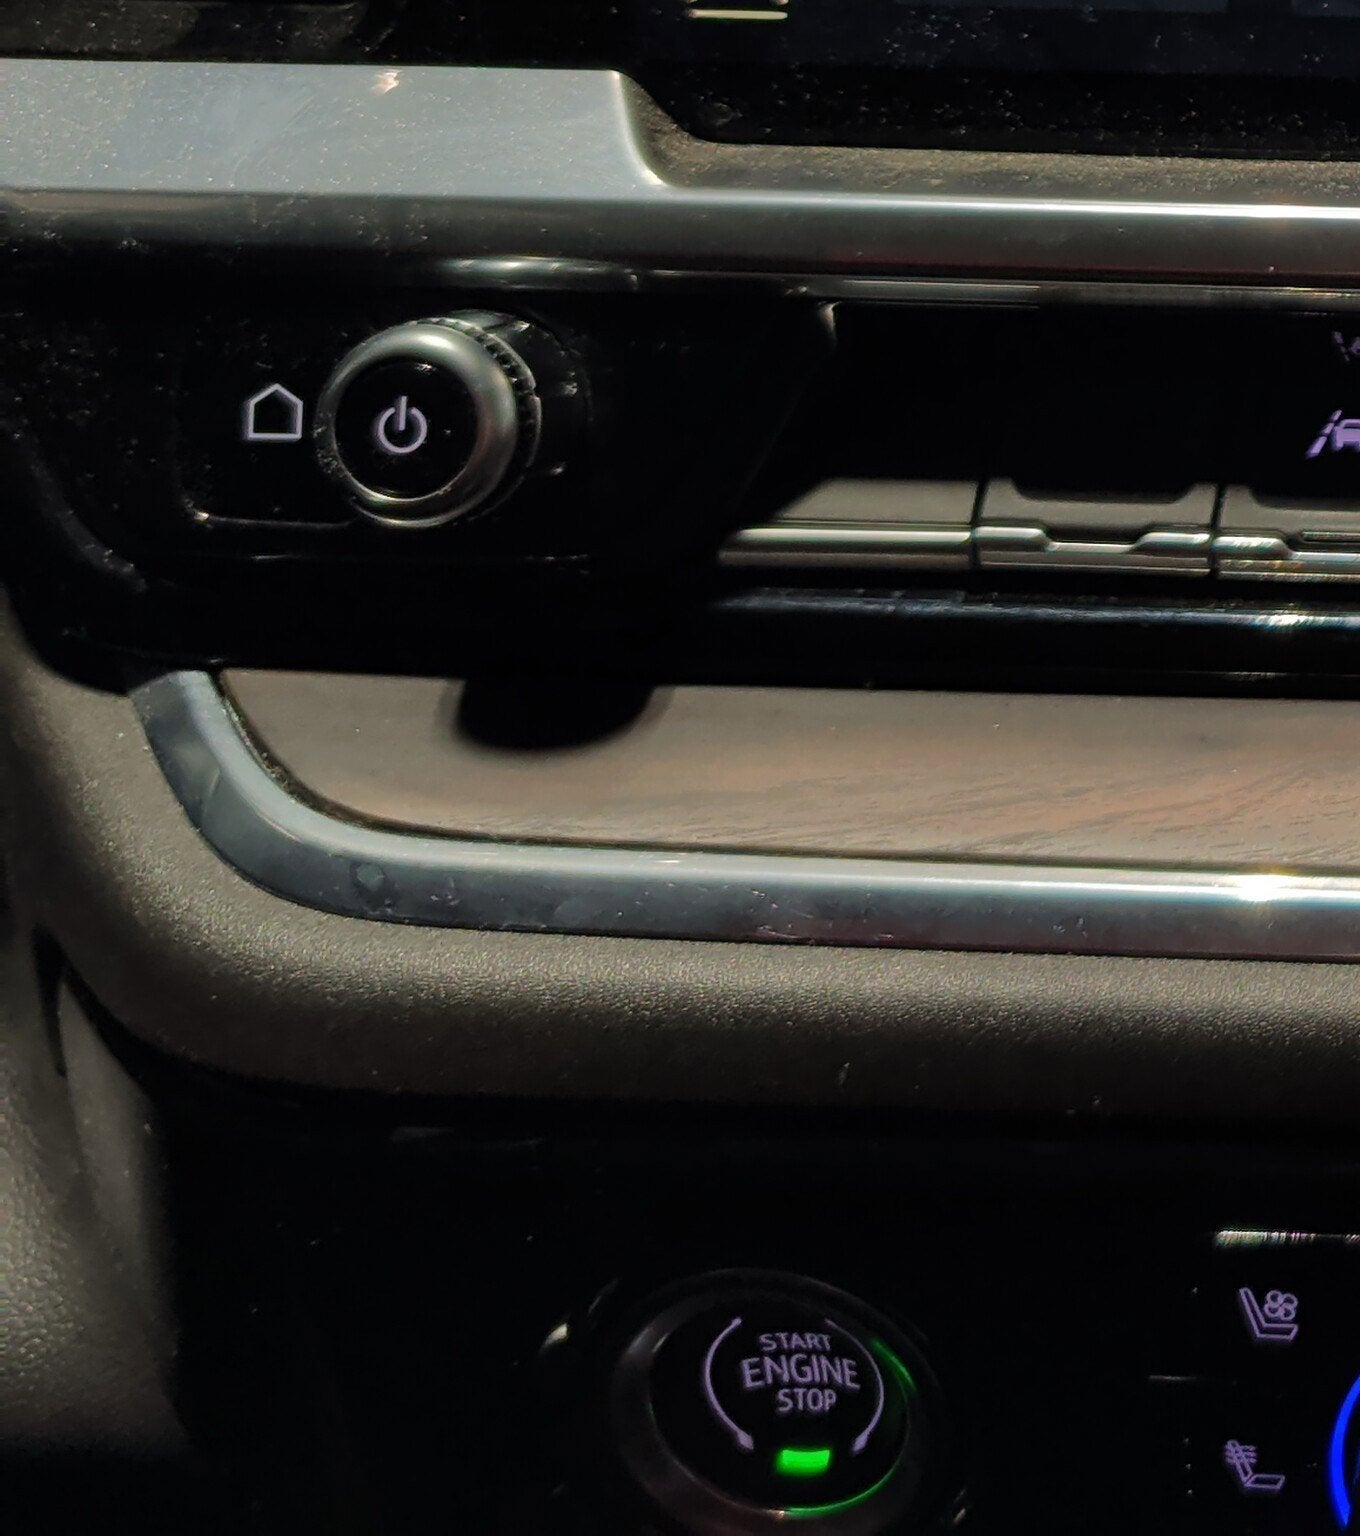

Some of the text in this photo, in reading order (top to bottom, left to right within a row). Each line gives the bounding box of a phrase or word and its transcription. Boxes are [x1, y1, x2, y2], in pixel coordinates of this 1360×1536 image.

[758, 1331, 832, 1352] START
[740, 1353, 861, 1390] ENGINE
[776, 1387, 837, 1413] STOP
